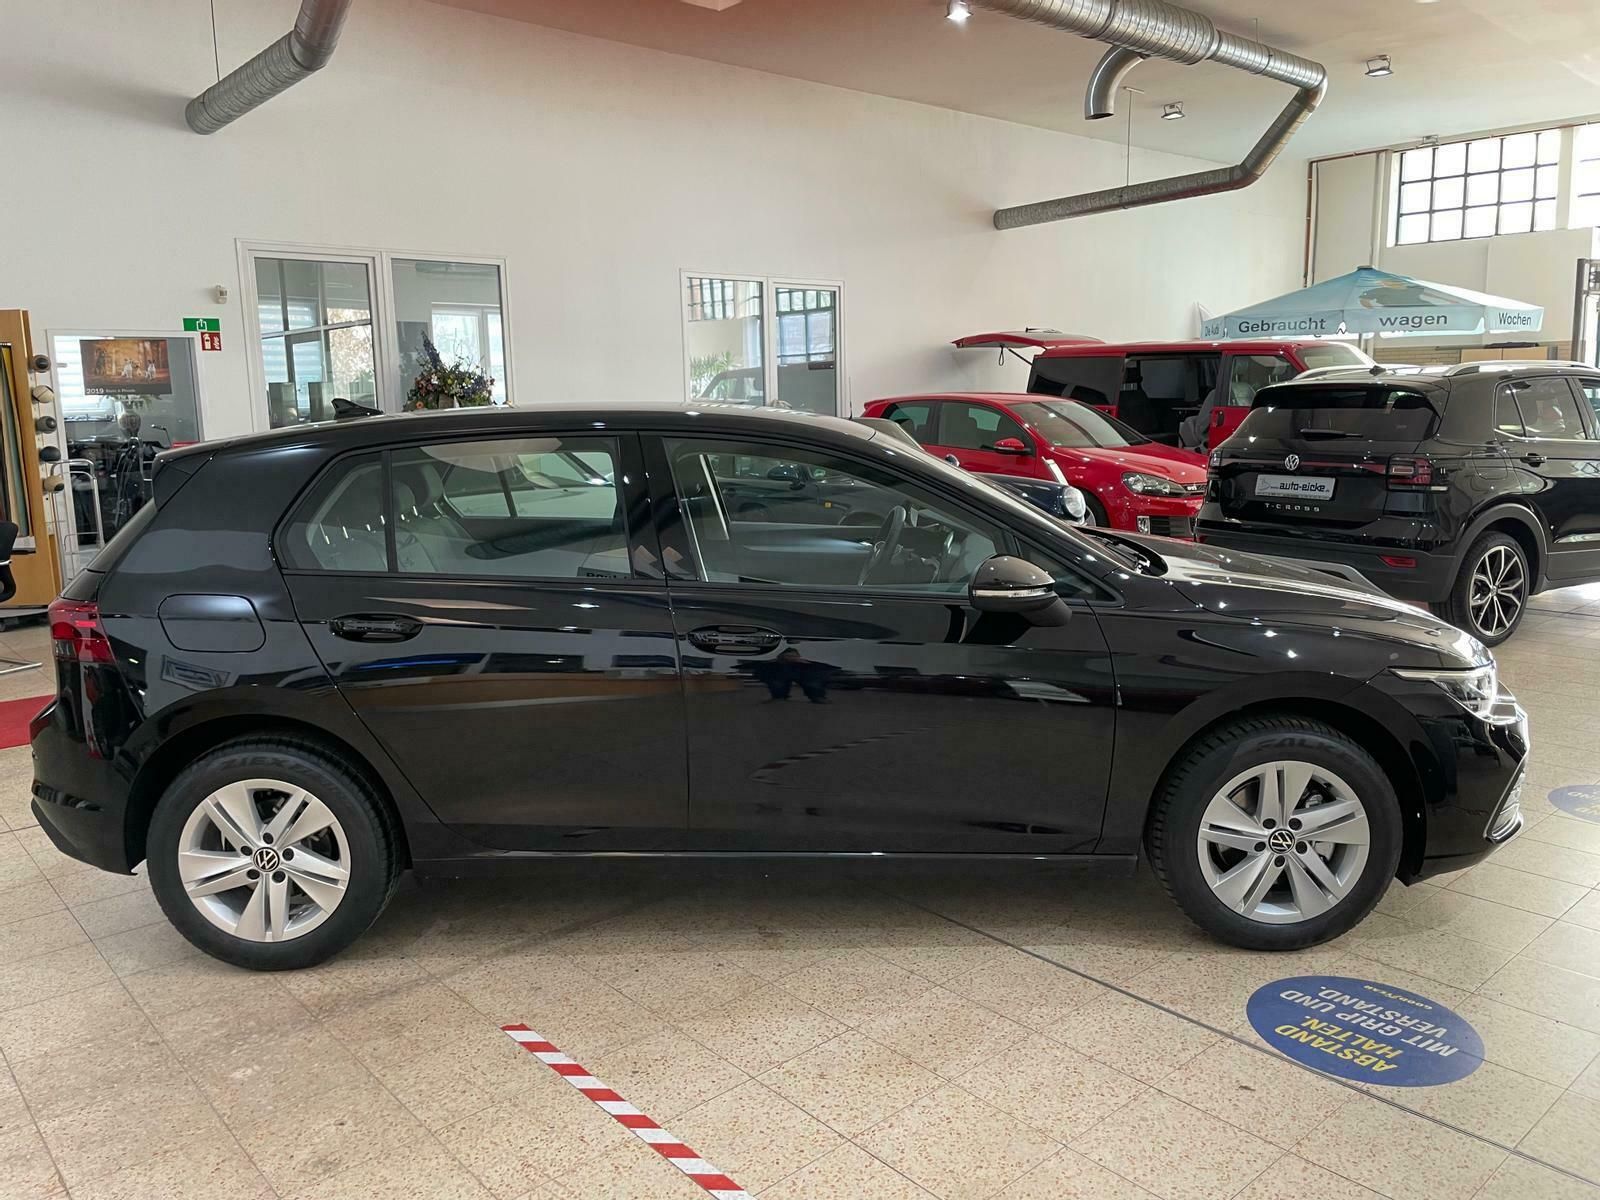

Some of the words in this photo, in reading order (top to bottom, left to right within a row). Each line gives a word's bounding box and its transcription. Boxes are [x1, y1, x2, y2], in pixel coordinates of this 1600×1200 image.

[1238, 318, 1326, 333] Gebraucht
[1379, 313, 1448, 329] wagen
[1498, 312, 1532, 326] Wochen
[1264, 503, 1320, 512] T-CROSS
[1279, 990, 1336, 1013] UND
[1320, 986, 1447, 1039] VERSTAND.
[1335, 1012, 1402, 1037] GRIP
[1274, 1024, 1398, 1072] ABSTAND
[1300, 1015, 1403, 1059] HALTEN.
[1401, 1038, 1458, 1057] MIT
